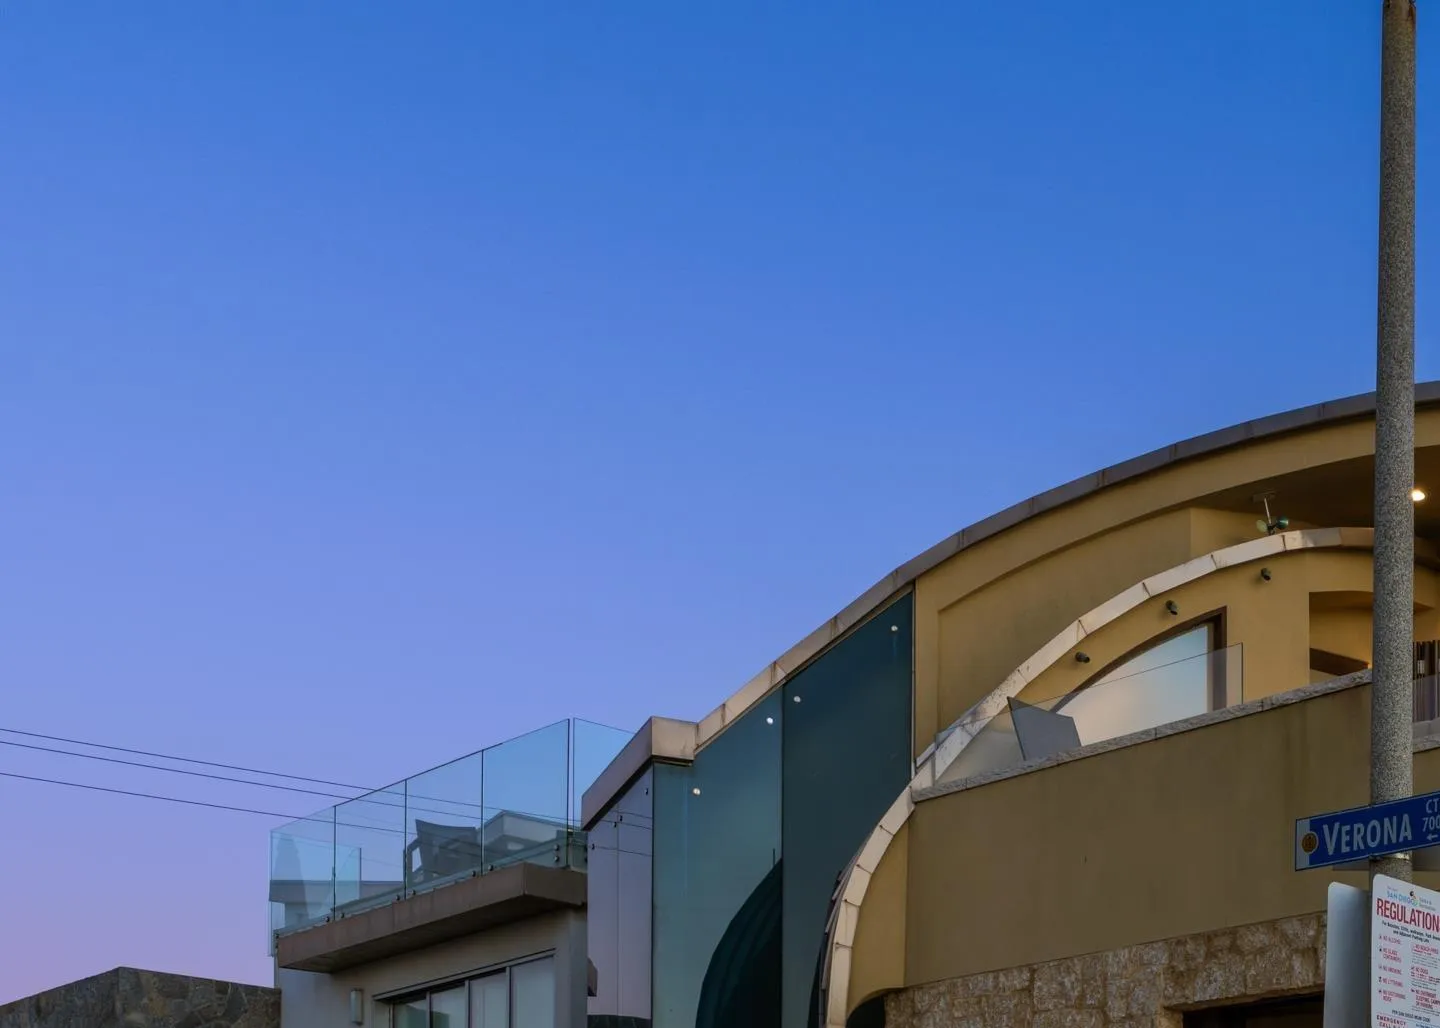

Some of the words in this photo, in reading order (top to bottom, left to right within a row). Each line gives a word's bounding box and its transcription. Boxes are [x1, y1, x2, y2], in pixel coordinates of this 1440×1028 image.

[1323, 813, 1412, 856] VERONA
[1425, 798, 1440, 814] CT
[1386, 890, 1397, 900] SAN
[1376, 1014, 1406, 1026] EMERGENCY
